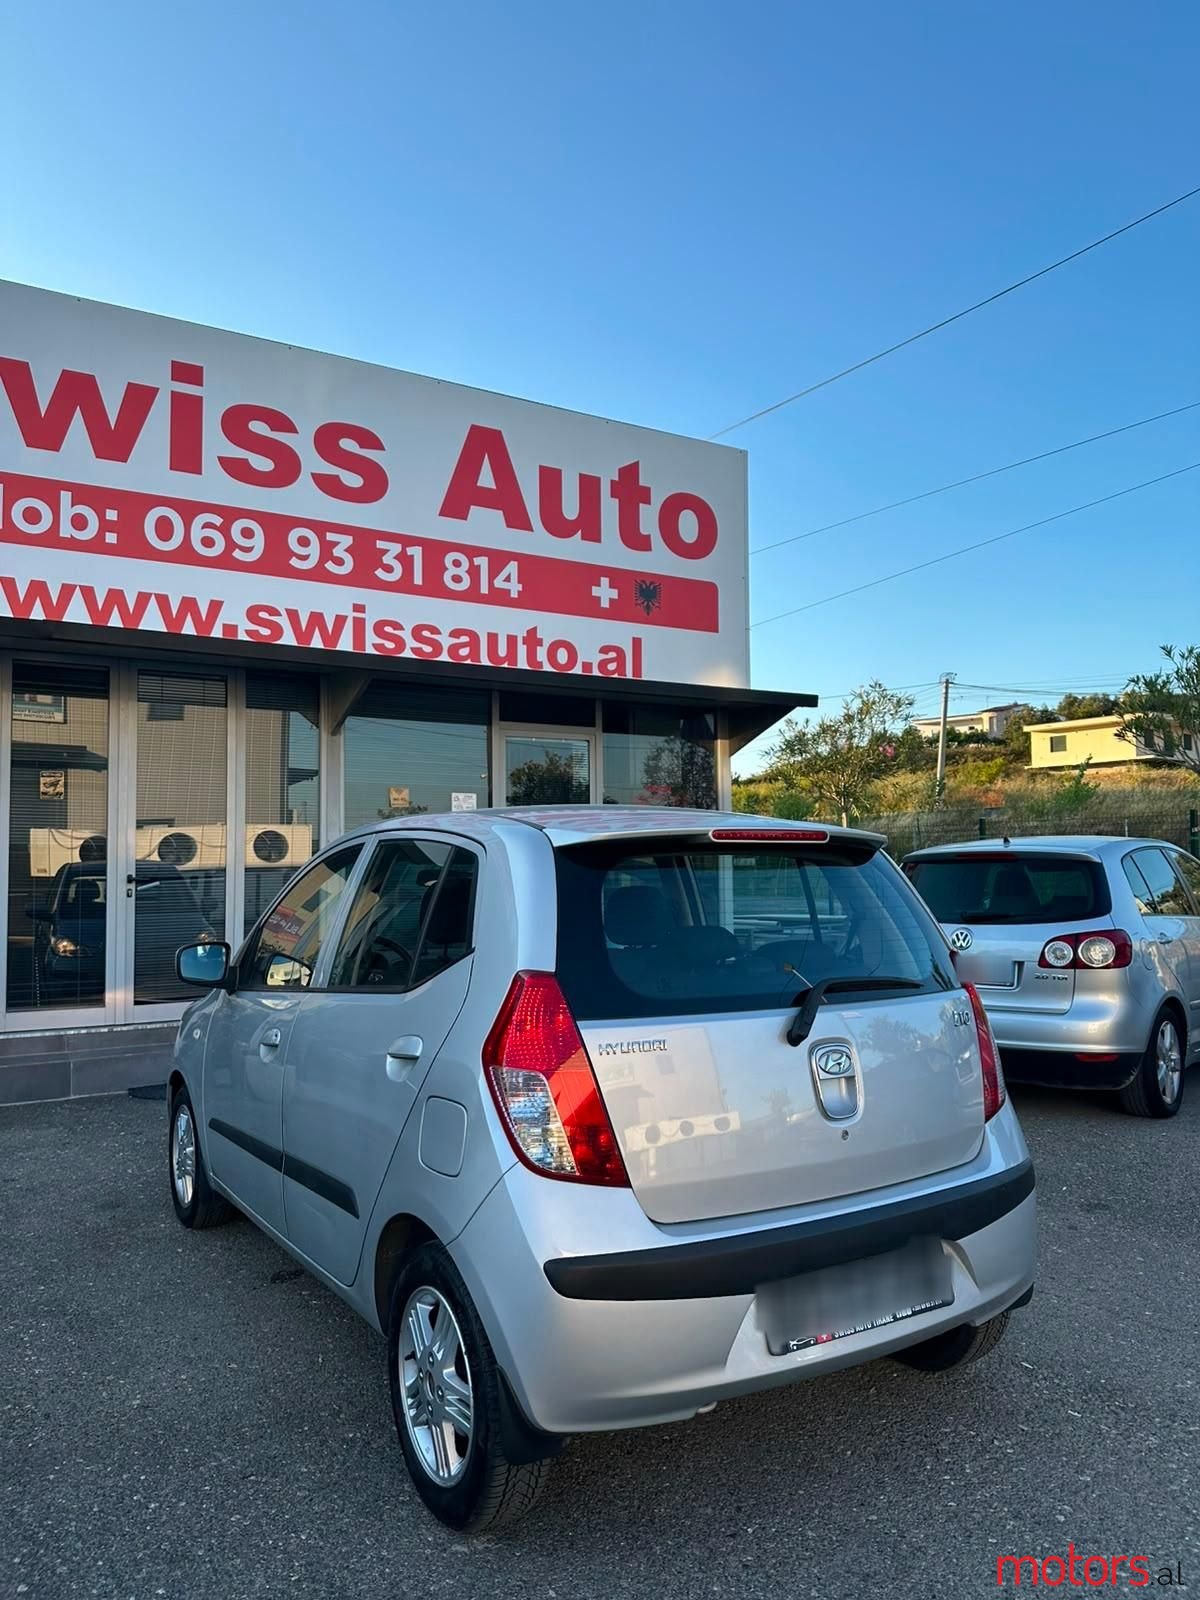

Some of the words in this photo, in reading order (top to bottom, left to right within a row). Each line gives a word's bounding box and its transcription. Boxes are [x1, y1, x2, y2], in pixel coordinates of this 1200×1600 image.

[0, 483, 118, 545] ob:
[144, 506, 265, 561] 069
[287, 527, 354, 575] 93
[375, 540, 423, 586] 31
[443, 552, 523, 598] 814
[438, 423, 718, 560] Auto
[0, 576, 642, 679] www.swissauto.al
[598, 1039, 667, 1056] HYUNDAI
